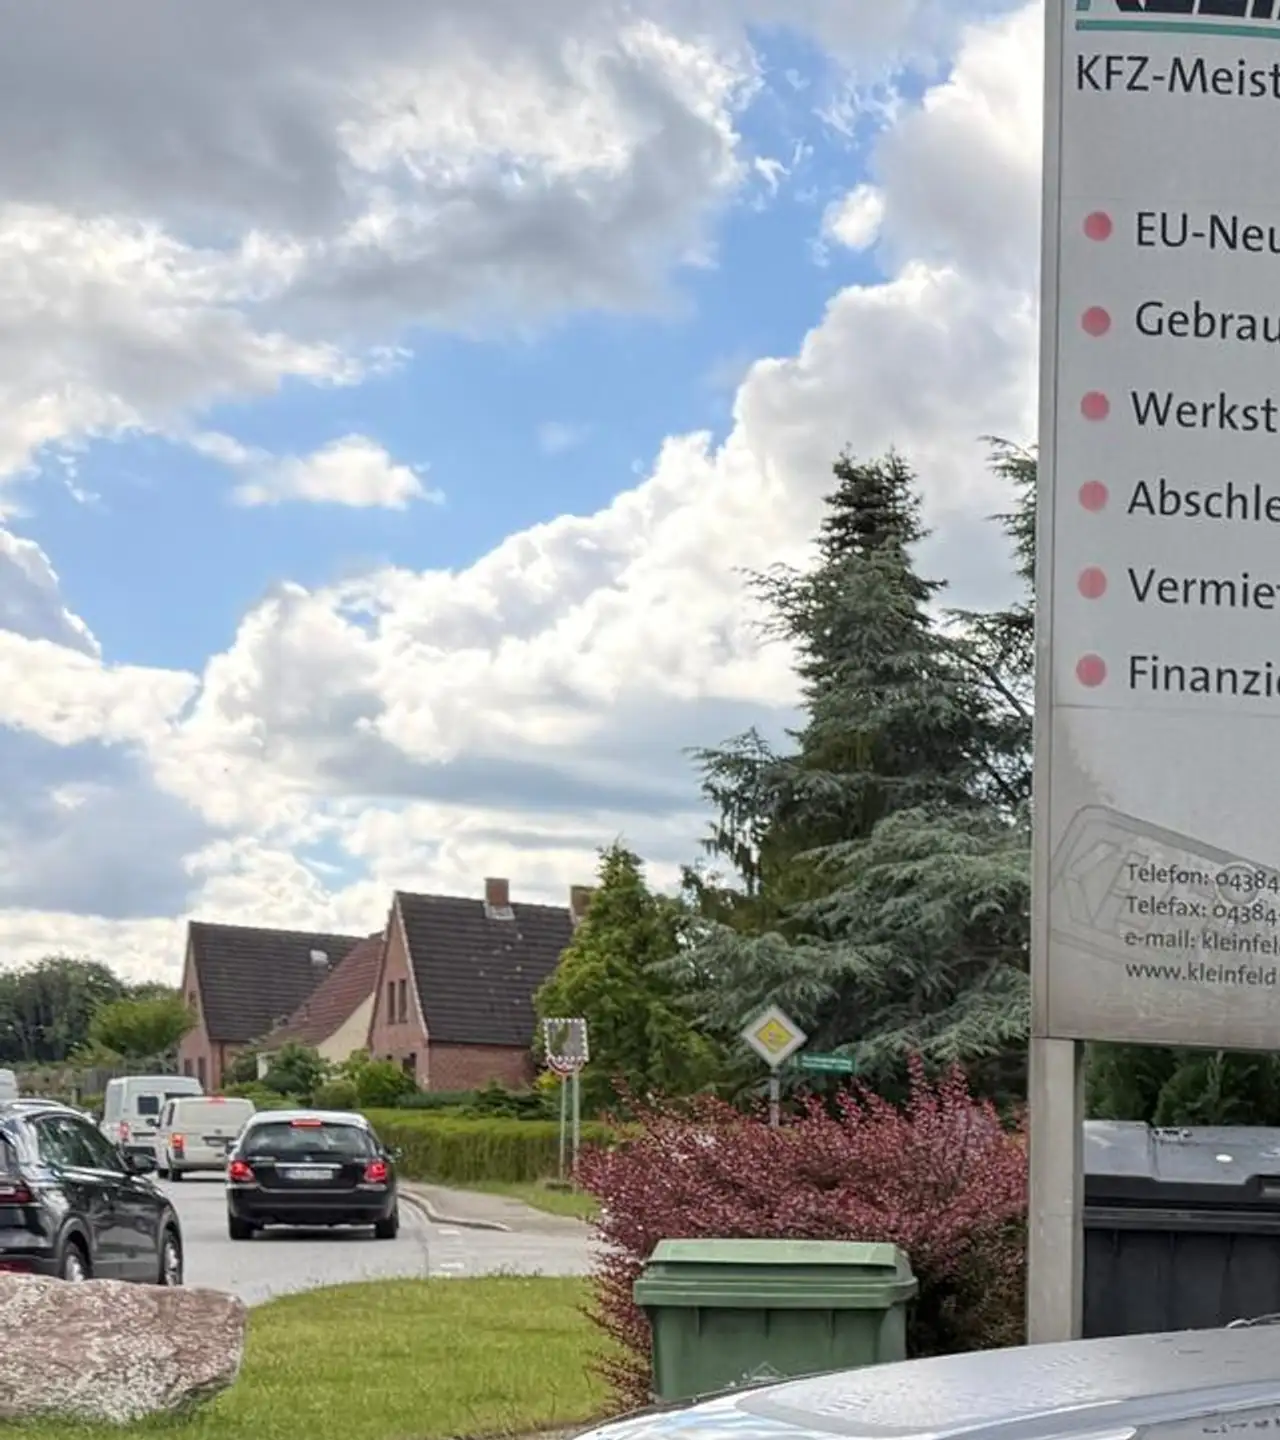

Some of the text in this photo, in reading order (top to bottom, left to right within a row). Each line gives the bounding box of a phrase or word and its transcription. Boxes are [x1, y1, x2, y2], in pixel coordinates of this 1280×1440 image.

[1124, 862, 1209, 886] Telefon:
[1124, 895, 1207, 919] Telefax:
[1124, 930, 1196, 949] e-mail:
